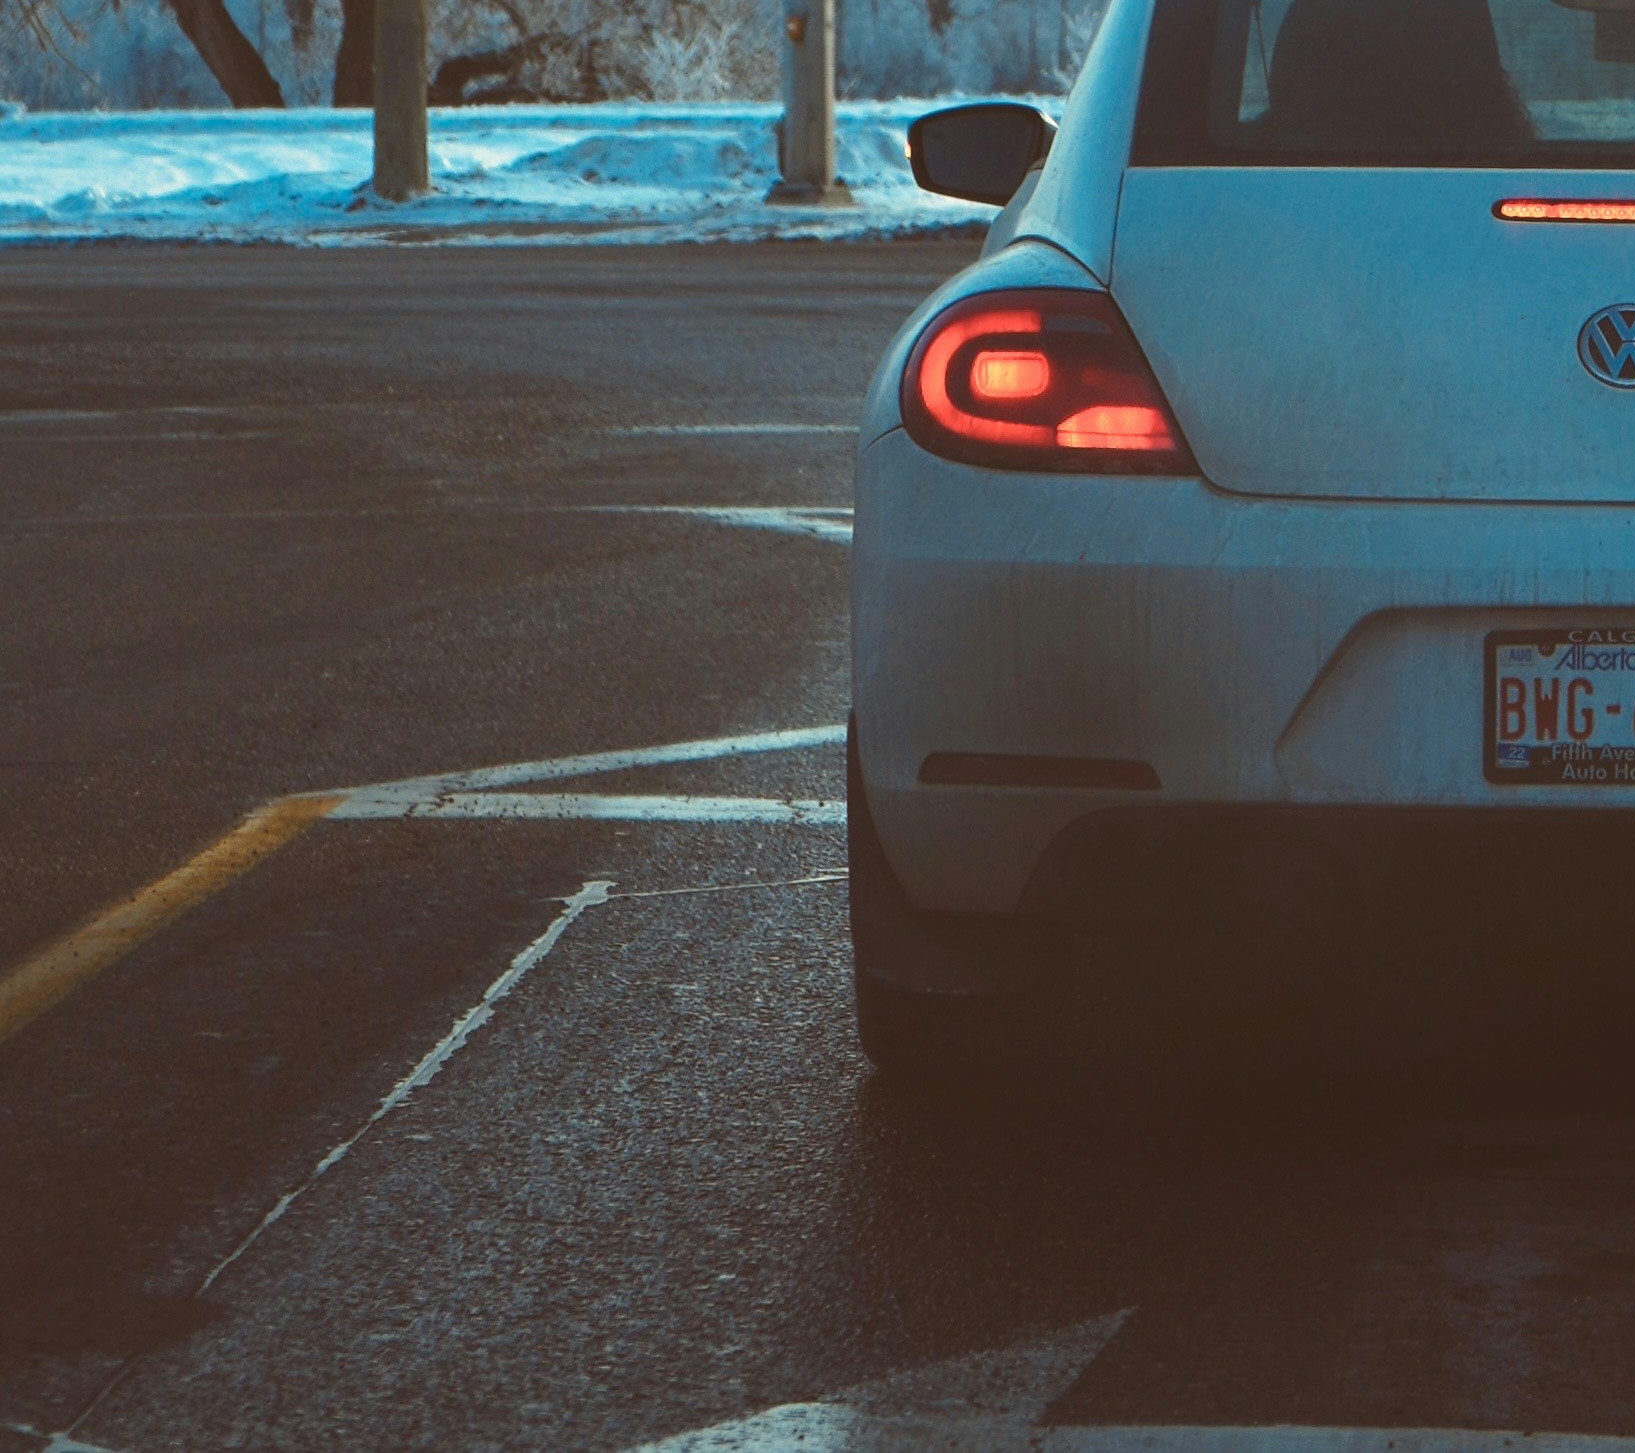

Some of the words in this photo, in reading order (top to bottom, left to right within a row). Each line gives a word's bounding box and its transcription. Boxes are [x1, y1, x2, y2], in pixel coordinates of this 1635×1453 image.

[1508, 745, 1527, 759] 22
[1551, 745, 1594, 761] Fifth
[1562, 763, 1607, 780] Auto
